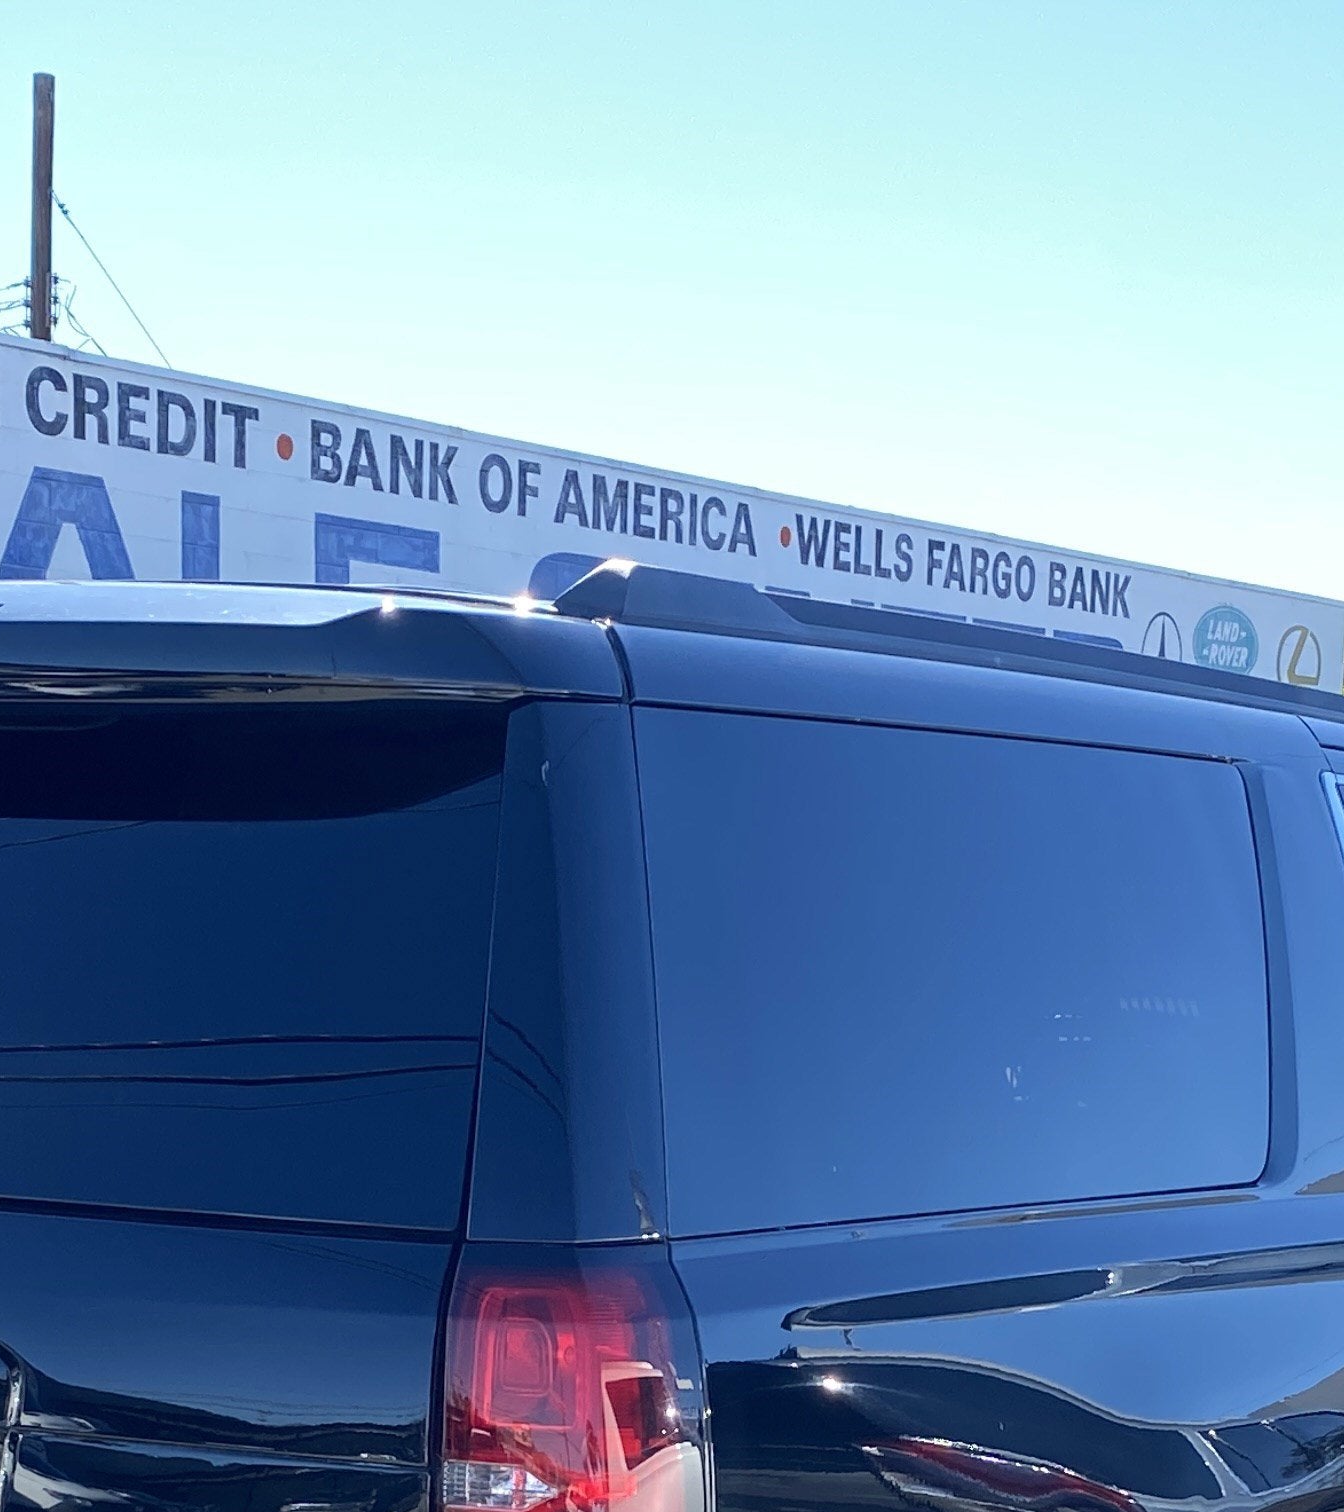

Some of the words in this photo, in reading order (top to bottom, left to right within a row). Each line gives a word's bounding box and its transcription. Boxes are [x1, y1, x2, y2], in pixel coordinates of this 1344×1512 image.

[26, 366, 258, 468] CREDIT
[311, 419, 458, 505] BANK
[479, 453, 541, 516] OF
[554, 469, 757, 557] AMERICA
[795, 513, 914, 582] WELLS
[927, 539, 1036, 602] FARGO
[1048, 561, 1132, 619] BANK
[1207, 619, 1240, 643] LAND
[1209, 642, 1248, 667] ROVER
